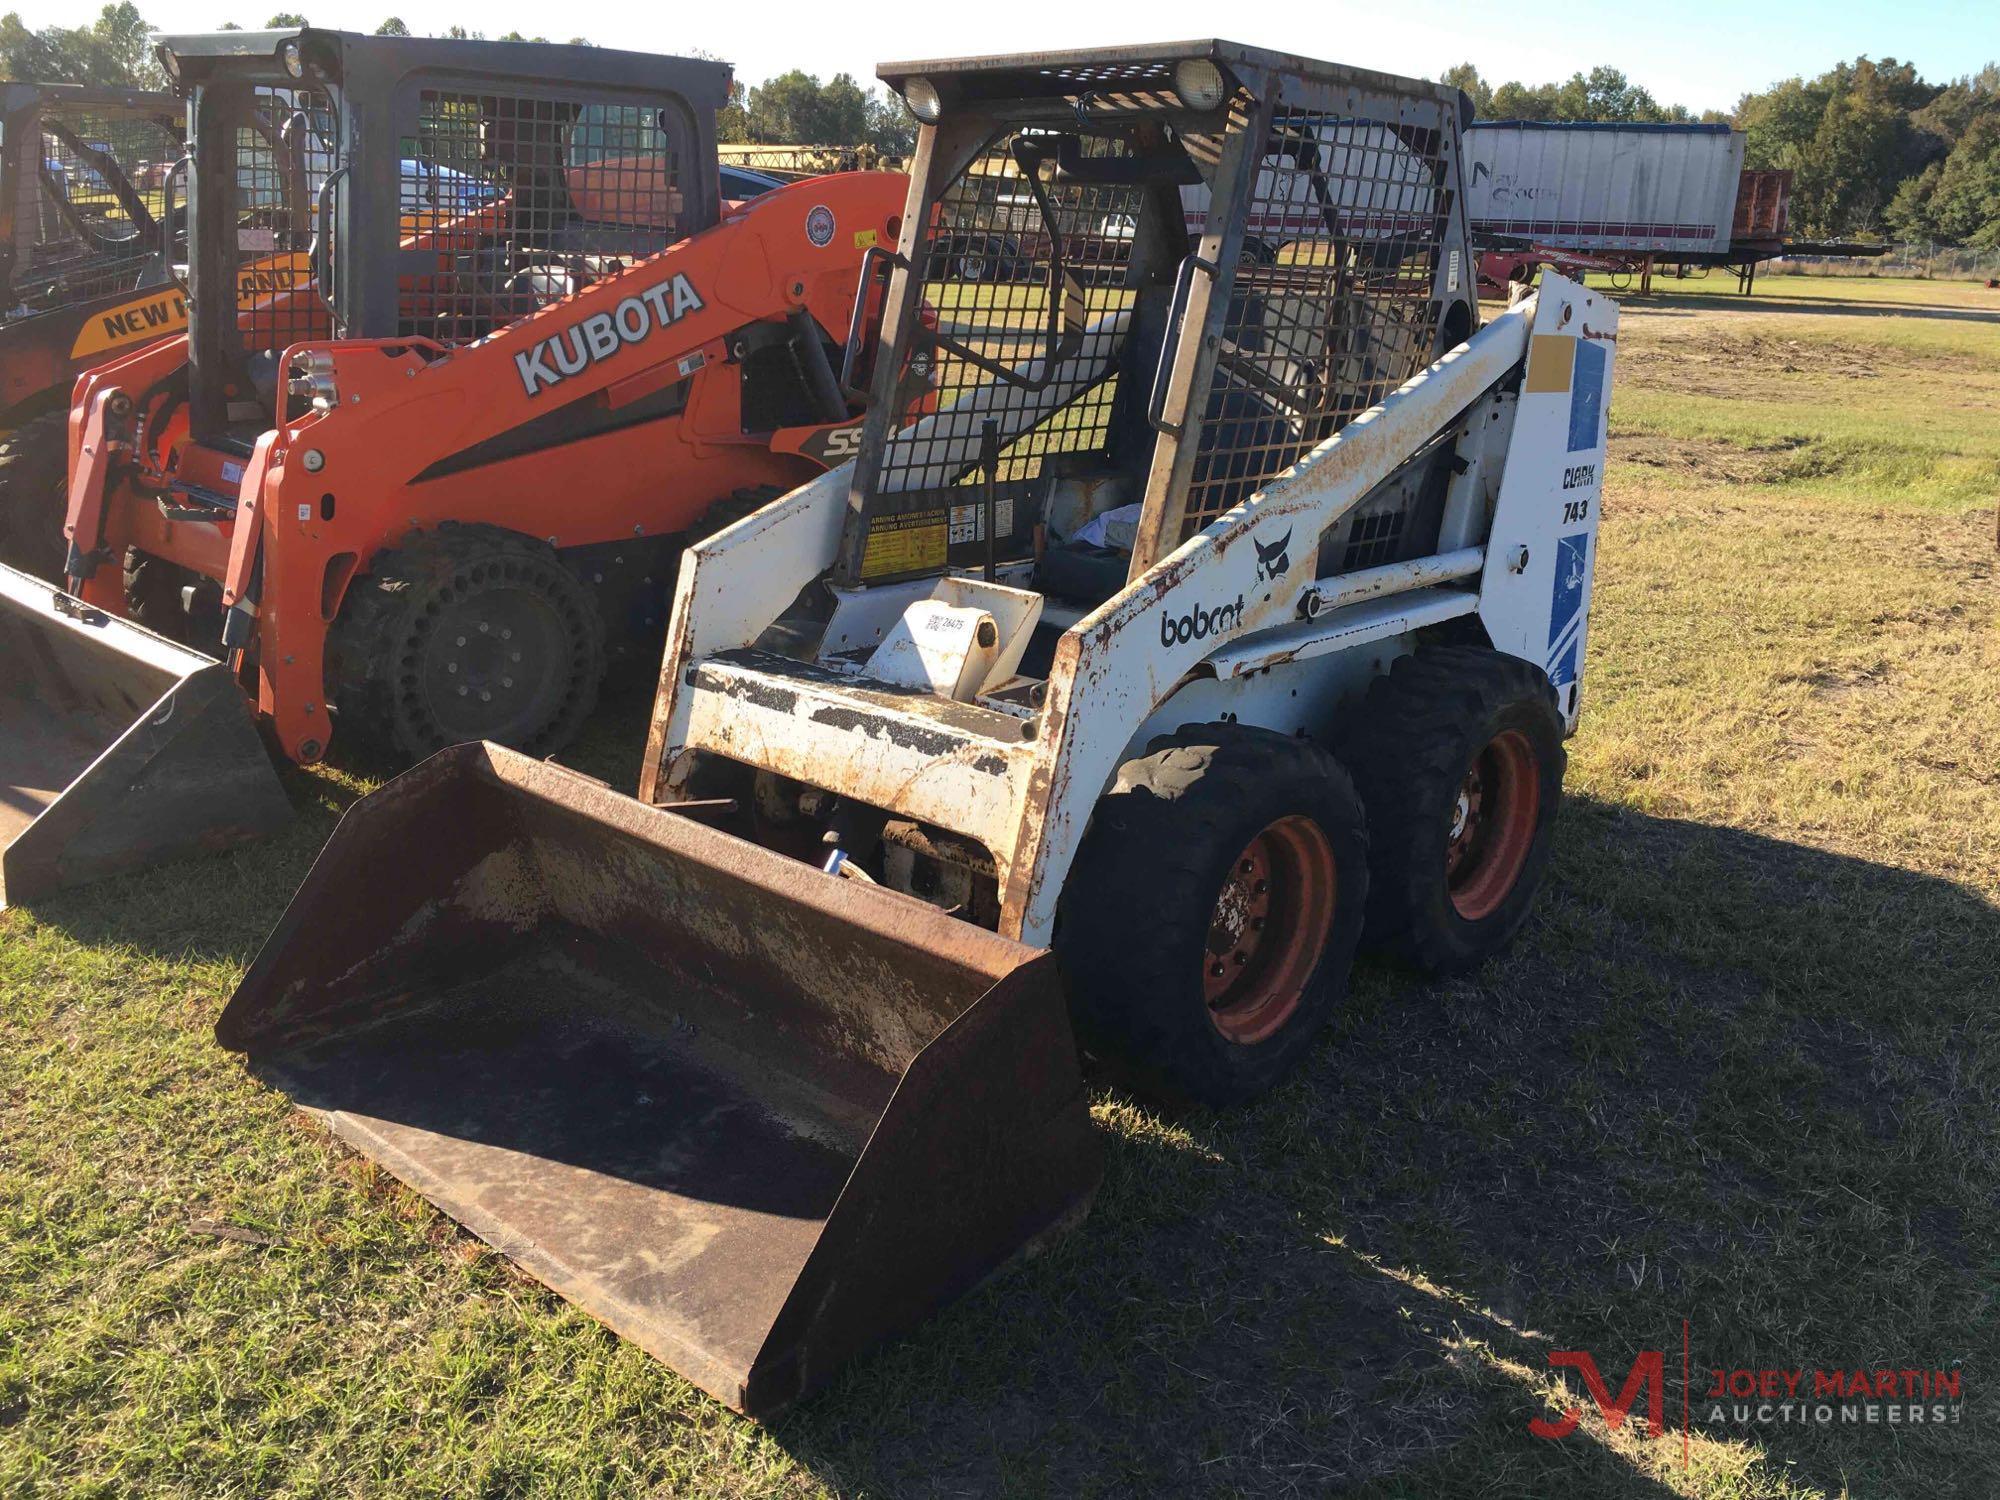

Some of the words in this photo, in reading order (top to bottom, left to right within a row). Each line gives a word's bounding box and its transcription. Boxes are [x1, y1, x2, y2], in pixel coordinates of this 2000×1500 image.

[102, 301, 168, 339] NEW
[515, 273, 704, 395] KUBOTA
[1563, 464, 1595, 489] CLARK
[1563, 500, 1588, 524] 743
[1161, 594, 1244, 648] bobcat
